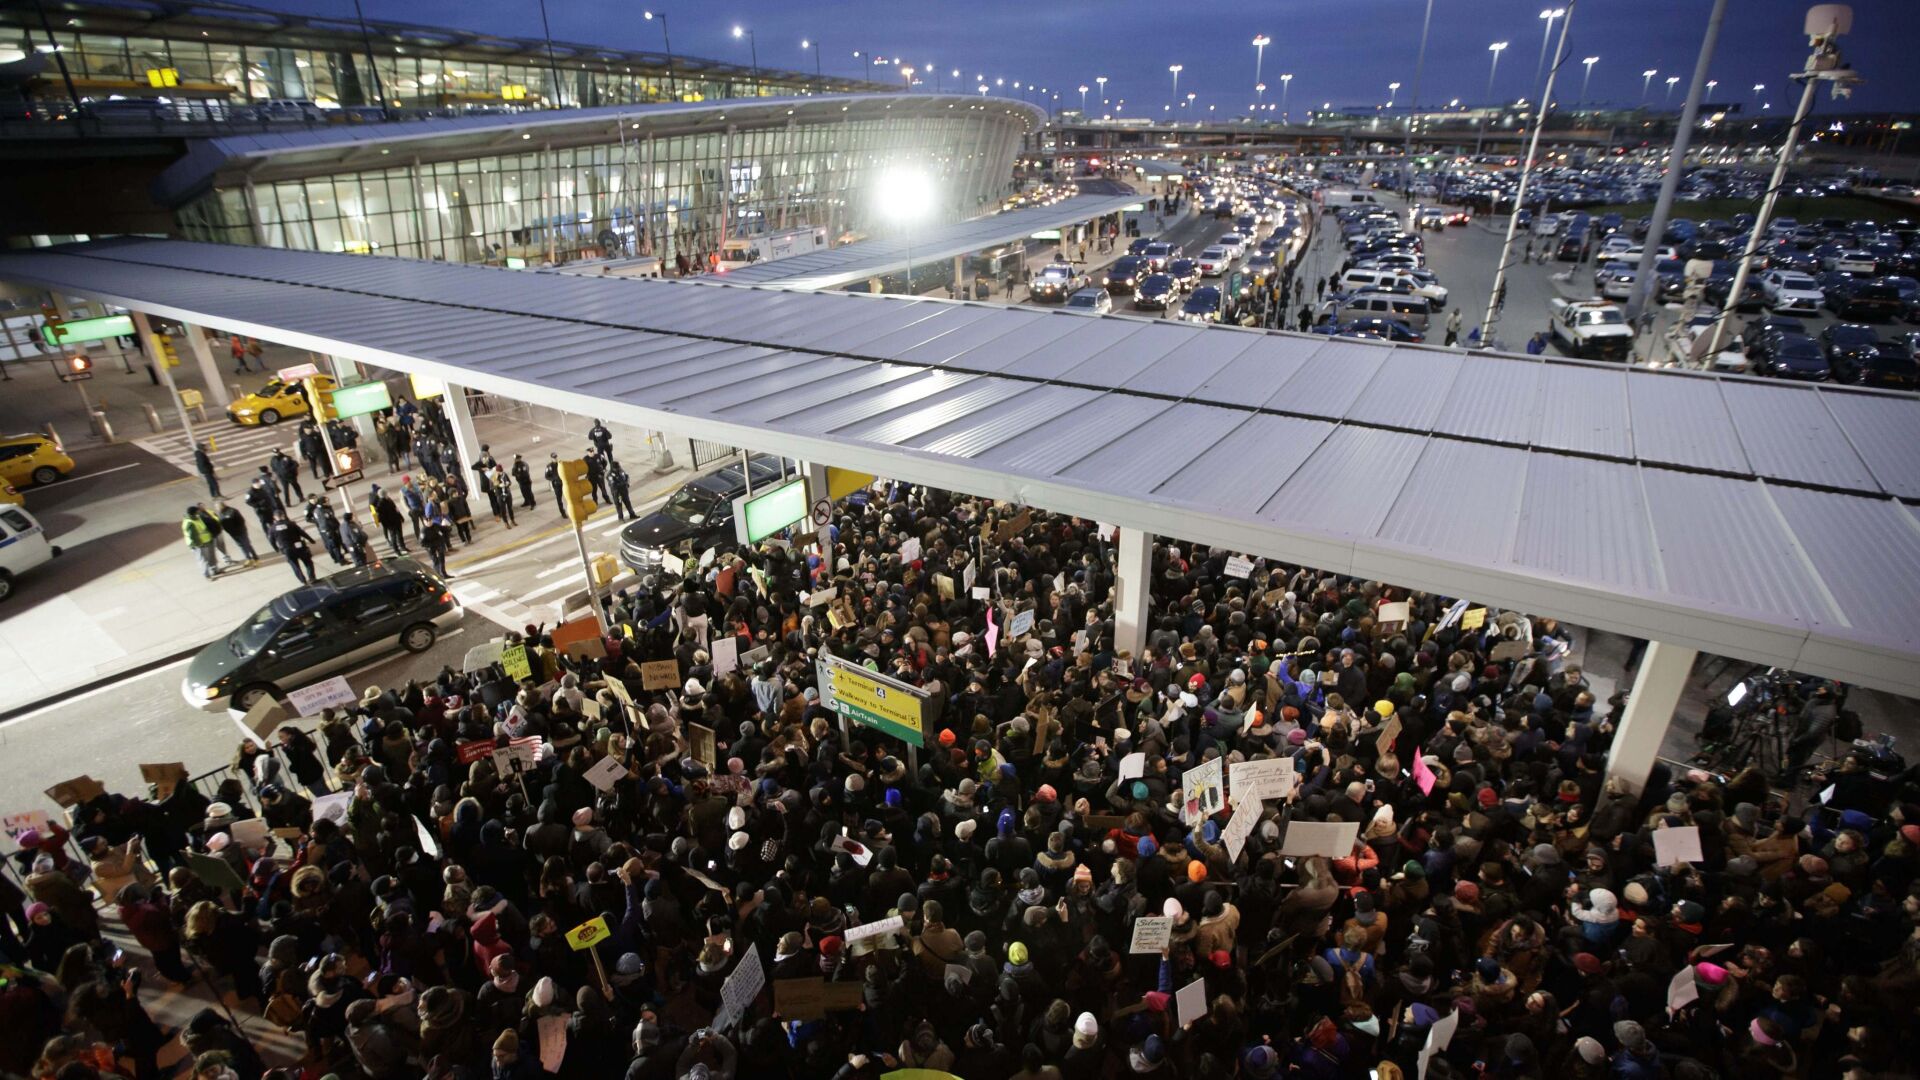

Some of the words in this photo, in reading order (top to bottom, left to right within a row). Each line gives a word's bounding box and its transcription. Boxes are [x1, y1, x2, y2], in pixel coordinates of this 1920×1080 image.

[848, 678, 875, 694] Terminal
[838, 689, 868, 706] Walkway
[870, 701, 877, 709] to
[879, 705, 907, 721] Terminal
[909, 717, 917, 726] 5
[849, 709, 878, 724] AirTrain
[1136, 919, 1166, 927] Silence
